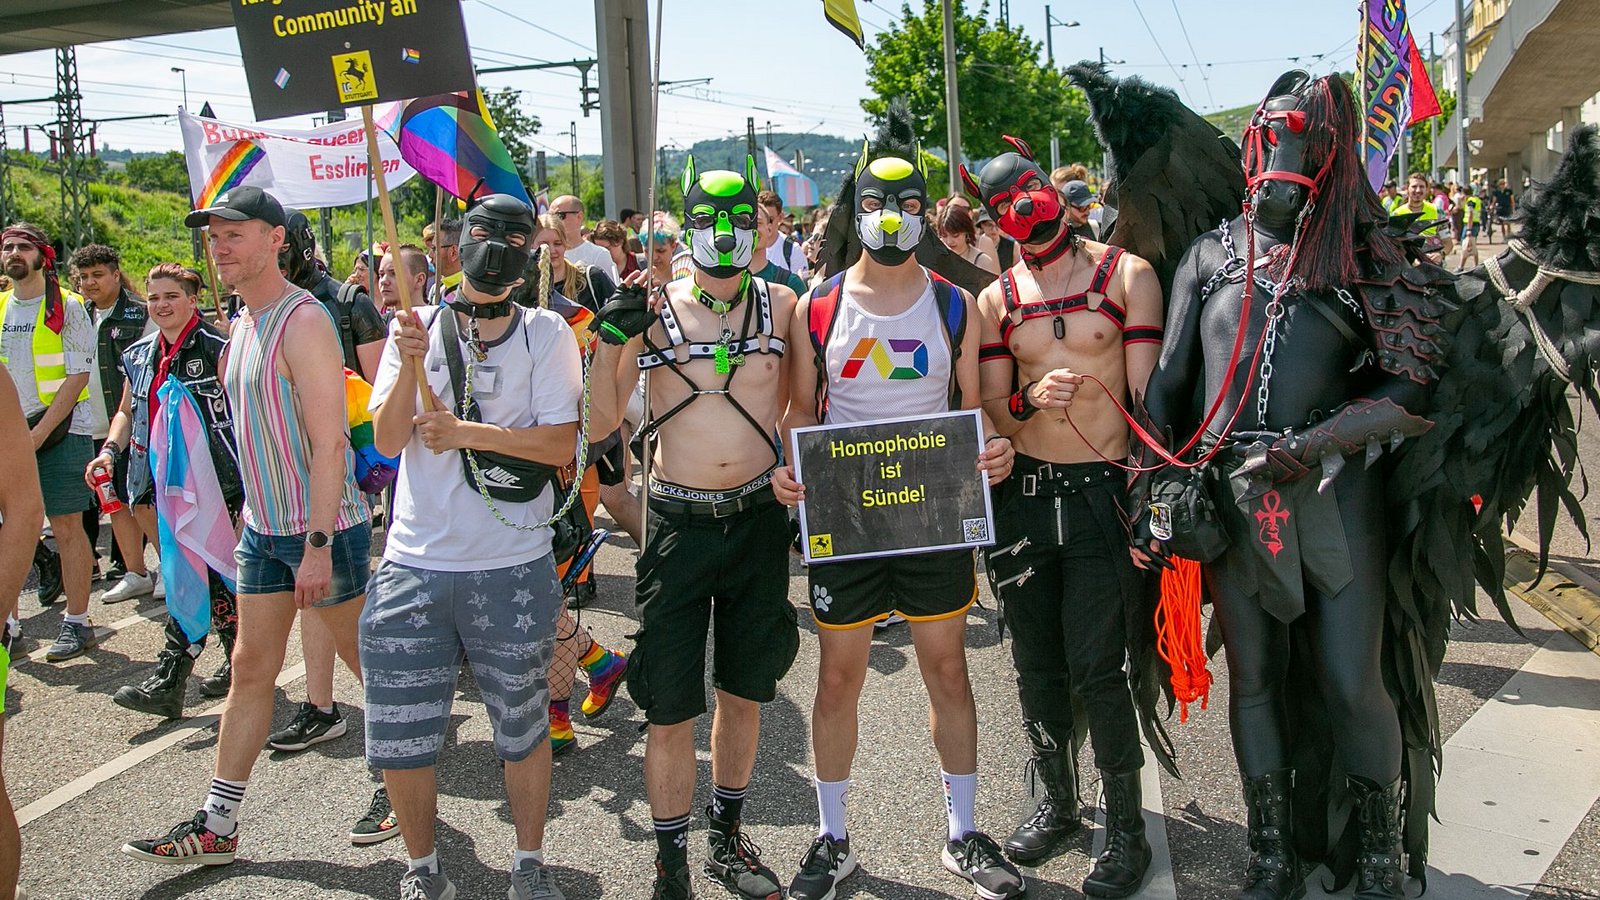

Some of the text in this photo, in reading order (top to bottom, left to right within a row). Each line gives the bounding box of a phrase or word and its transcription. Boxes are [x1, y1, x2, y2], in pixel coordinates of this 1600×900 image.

[273, 0, 417, 37] Community an
[344, 91, 373, 101] STUTTGART
[309, 155, 400, 180] Esslinen
[831, 431, 946, 459] Homophobie
[485, 466, 520, 484] NIKE
[880, 462, 901, 480] ist
[653, 482, 724, 501] JACK&JONES
[862, 485, 926, 508] Sünde!
